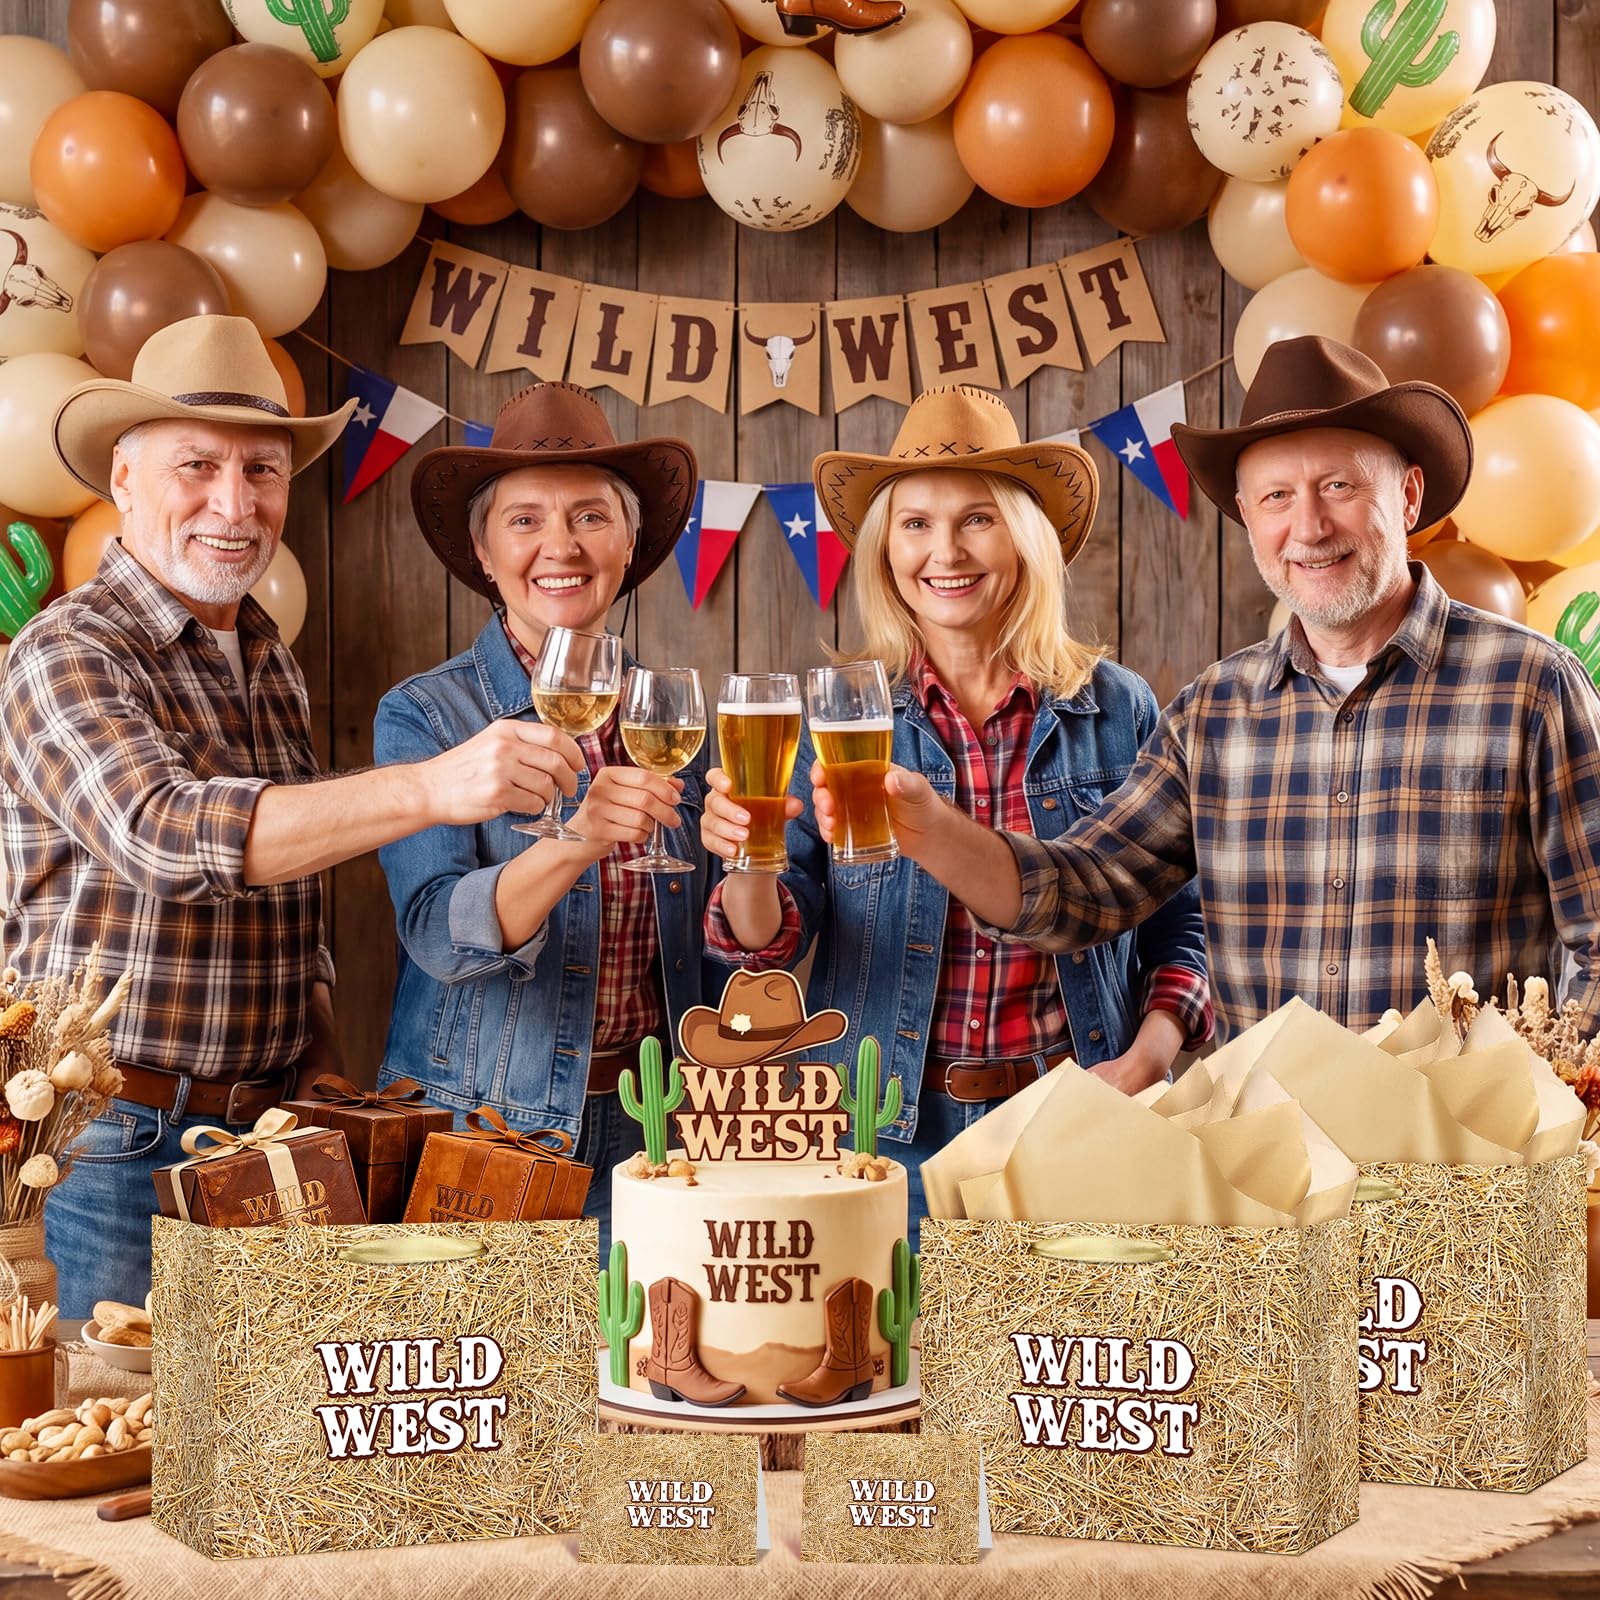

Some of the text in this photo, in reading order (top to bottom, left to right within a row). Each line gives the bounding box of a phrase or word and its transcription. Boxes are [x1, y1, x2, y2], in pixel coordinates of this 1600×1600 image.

[430, 257, 1132, 385] WILD WEST
[679, 1063, 844, 1112] WILD
[676, 1112, 849, 1161] WEST
[240, 1180, 327, 1224] WILD
[436, 1184, 495, 1219] WILD
[703, 1219, 815, 1259] WILD
[702, 1263, 820, 1304] WEST
[313, 1335, 506, 1397] WILD
[1009, 1331, 1198, 1396] WILD
[313, 1393, 509, 1461] WEST
[1009, 1393, 1199, 1457] WEST
[625, 1479, 714, 1504] WILD
[847, 1478, 936, 1503] WILD
[625, 1504, 715, 1530] WEST
[847, 1503, 937, 1529] WEST
